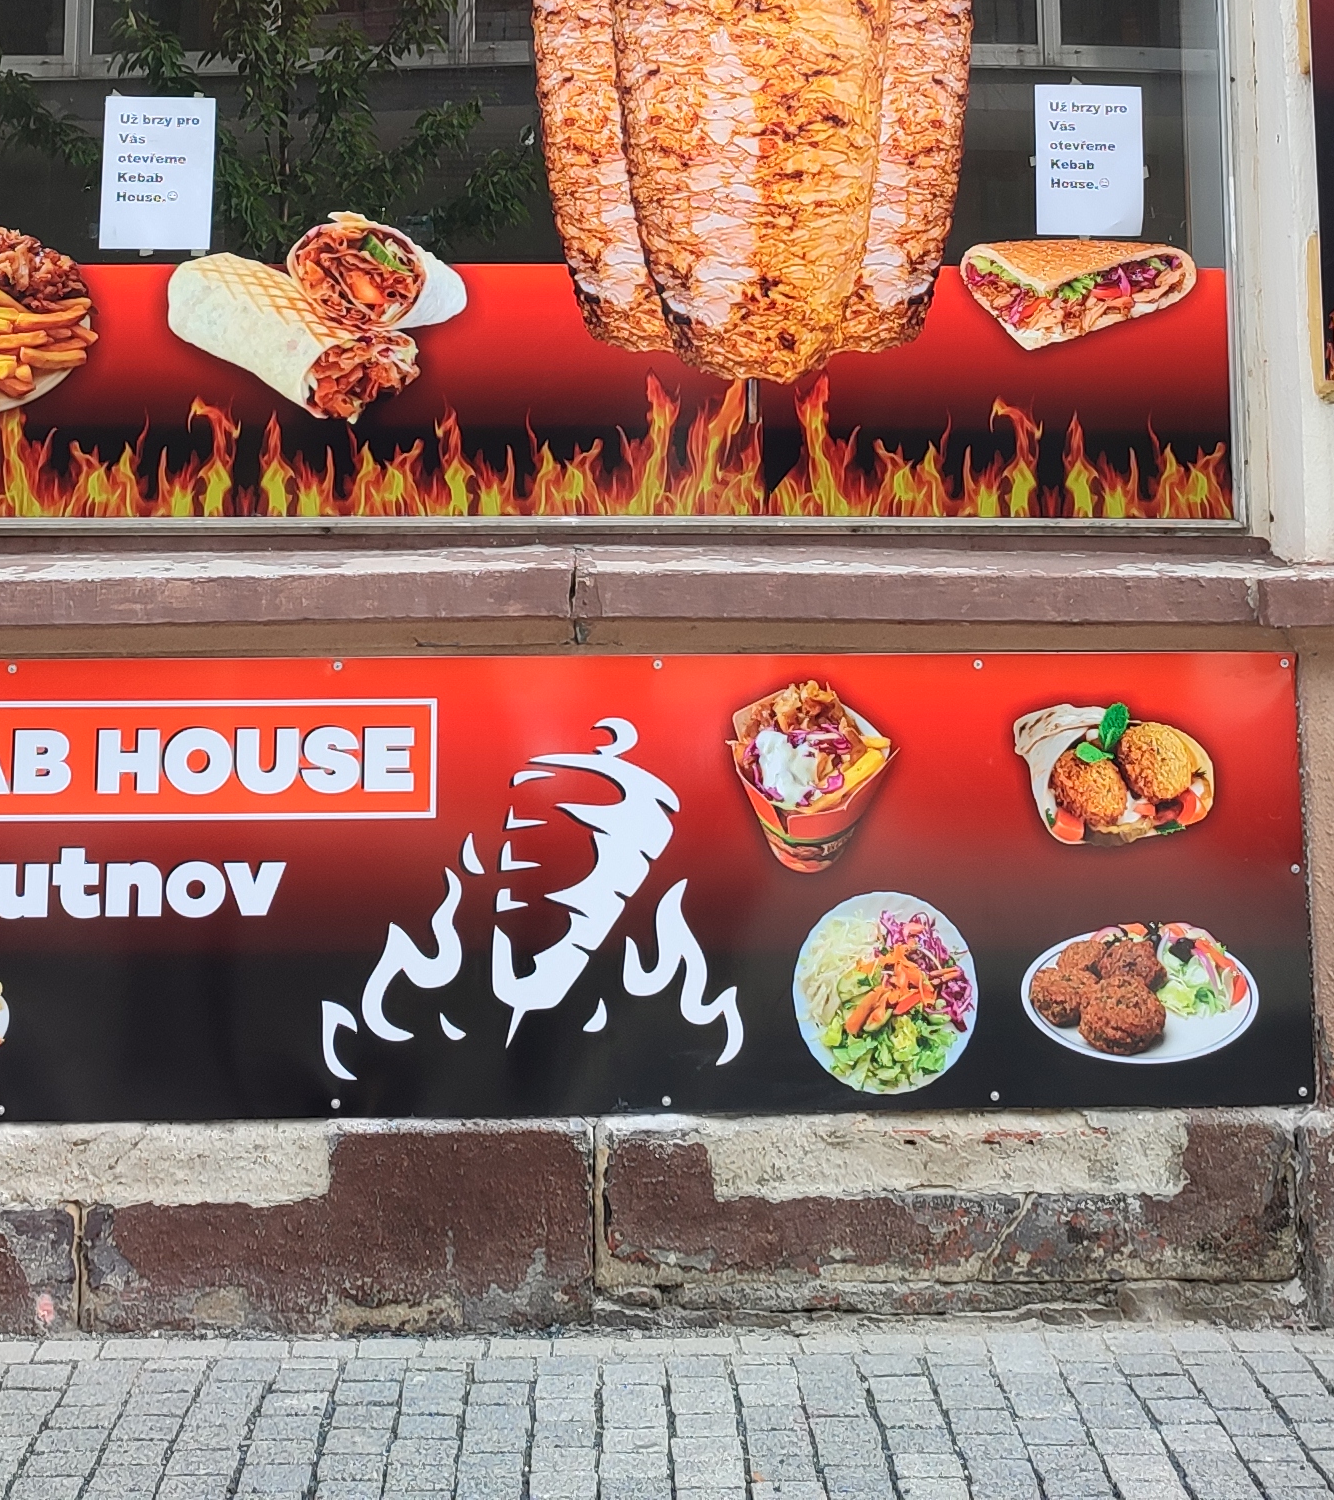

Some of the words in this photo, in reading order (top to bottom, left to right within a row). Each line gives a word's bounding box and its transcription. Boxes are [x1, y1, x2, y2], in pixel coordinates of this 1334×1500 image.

[1049, 101, 1068, 112] Už
[1071, 101, 1101, 115] brzy
[1105, 105, 1128, 116] pro
[120, 113, 139, 125] Už
[142, 114, 173, 128] brzy
[176, 117, 200, 128] pro
[1048, 120, 1076, 132] Vás
[118, 133, 146, 145] Vás
[1049, 140, 1116, 152] otevřeme
[117, 153, 187, 165] otevřeme
[1050, 158, 1095, 170] Kebab
[117, 172, 164, 183] Kebab
[1050, 177, 1099, 190] House.
[116, 191, 166, 203] House.
[97, 727, 414, 794] HOUSE
